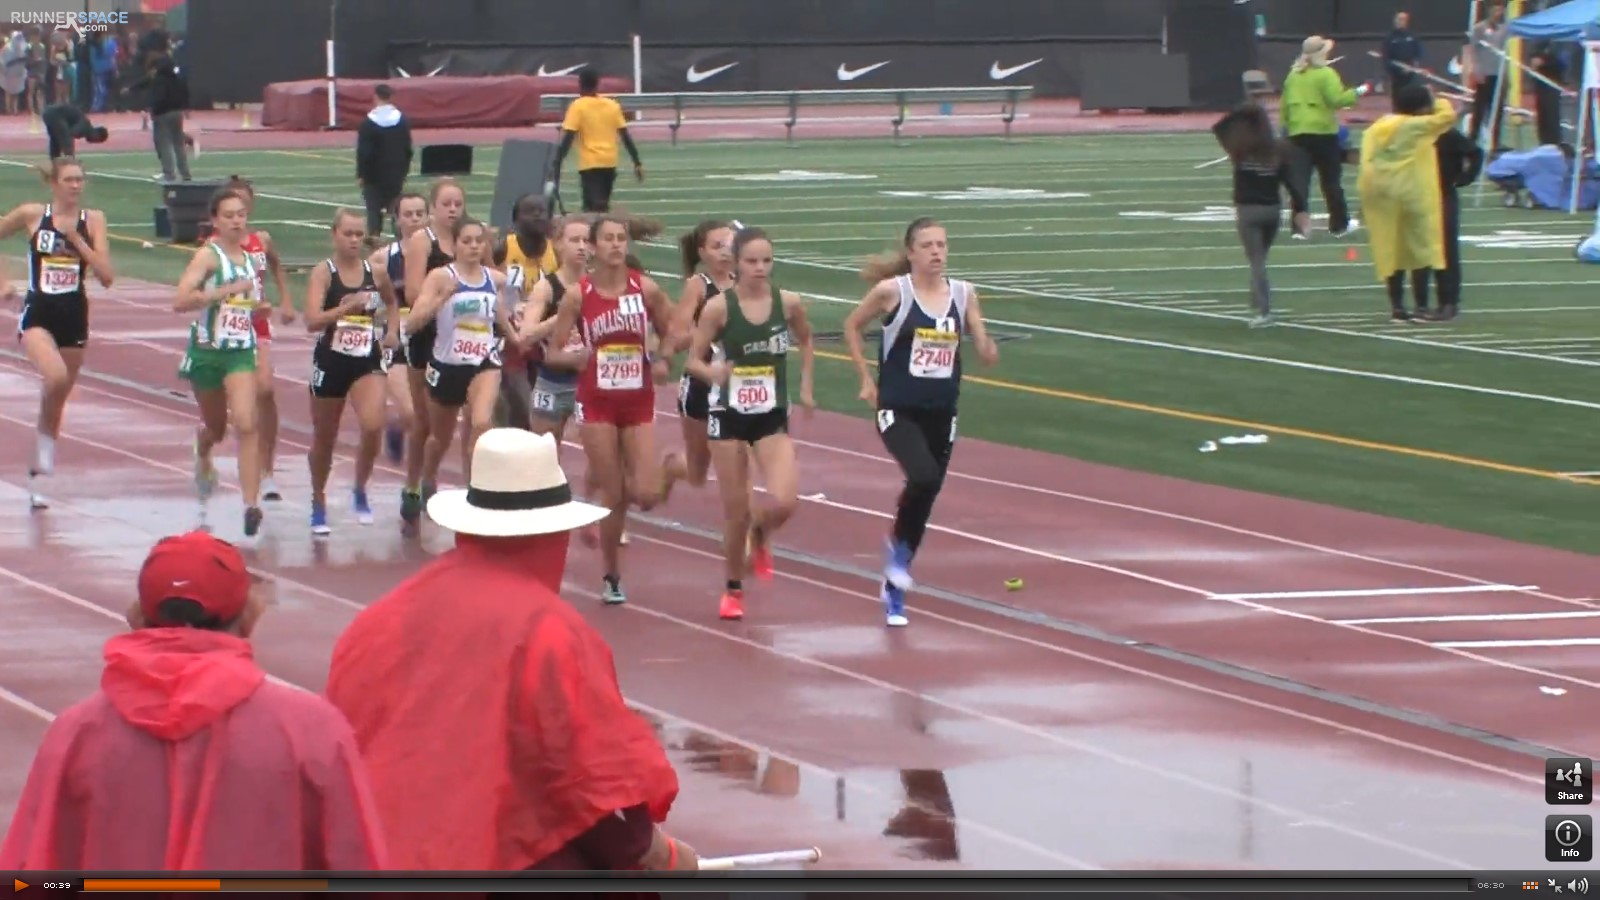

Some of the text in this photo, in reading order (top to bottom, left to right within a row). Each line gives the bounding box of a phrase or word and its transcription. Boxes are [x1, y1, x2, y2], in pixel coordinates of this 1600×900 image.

[40, 232, 51, 250] 8
[510, 266, 520, 285] 7
[624, 296, 641, 313] 11
[453, 339, 488, 357] 3845
[912, 348, 953, 367] 2740
[601, 361, 640, 379] 2799
[537, 393, 551, 408] 15
[737, 386, 768, 404] 600
